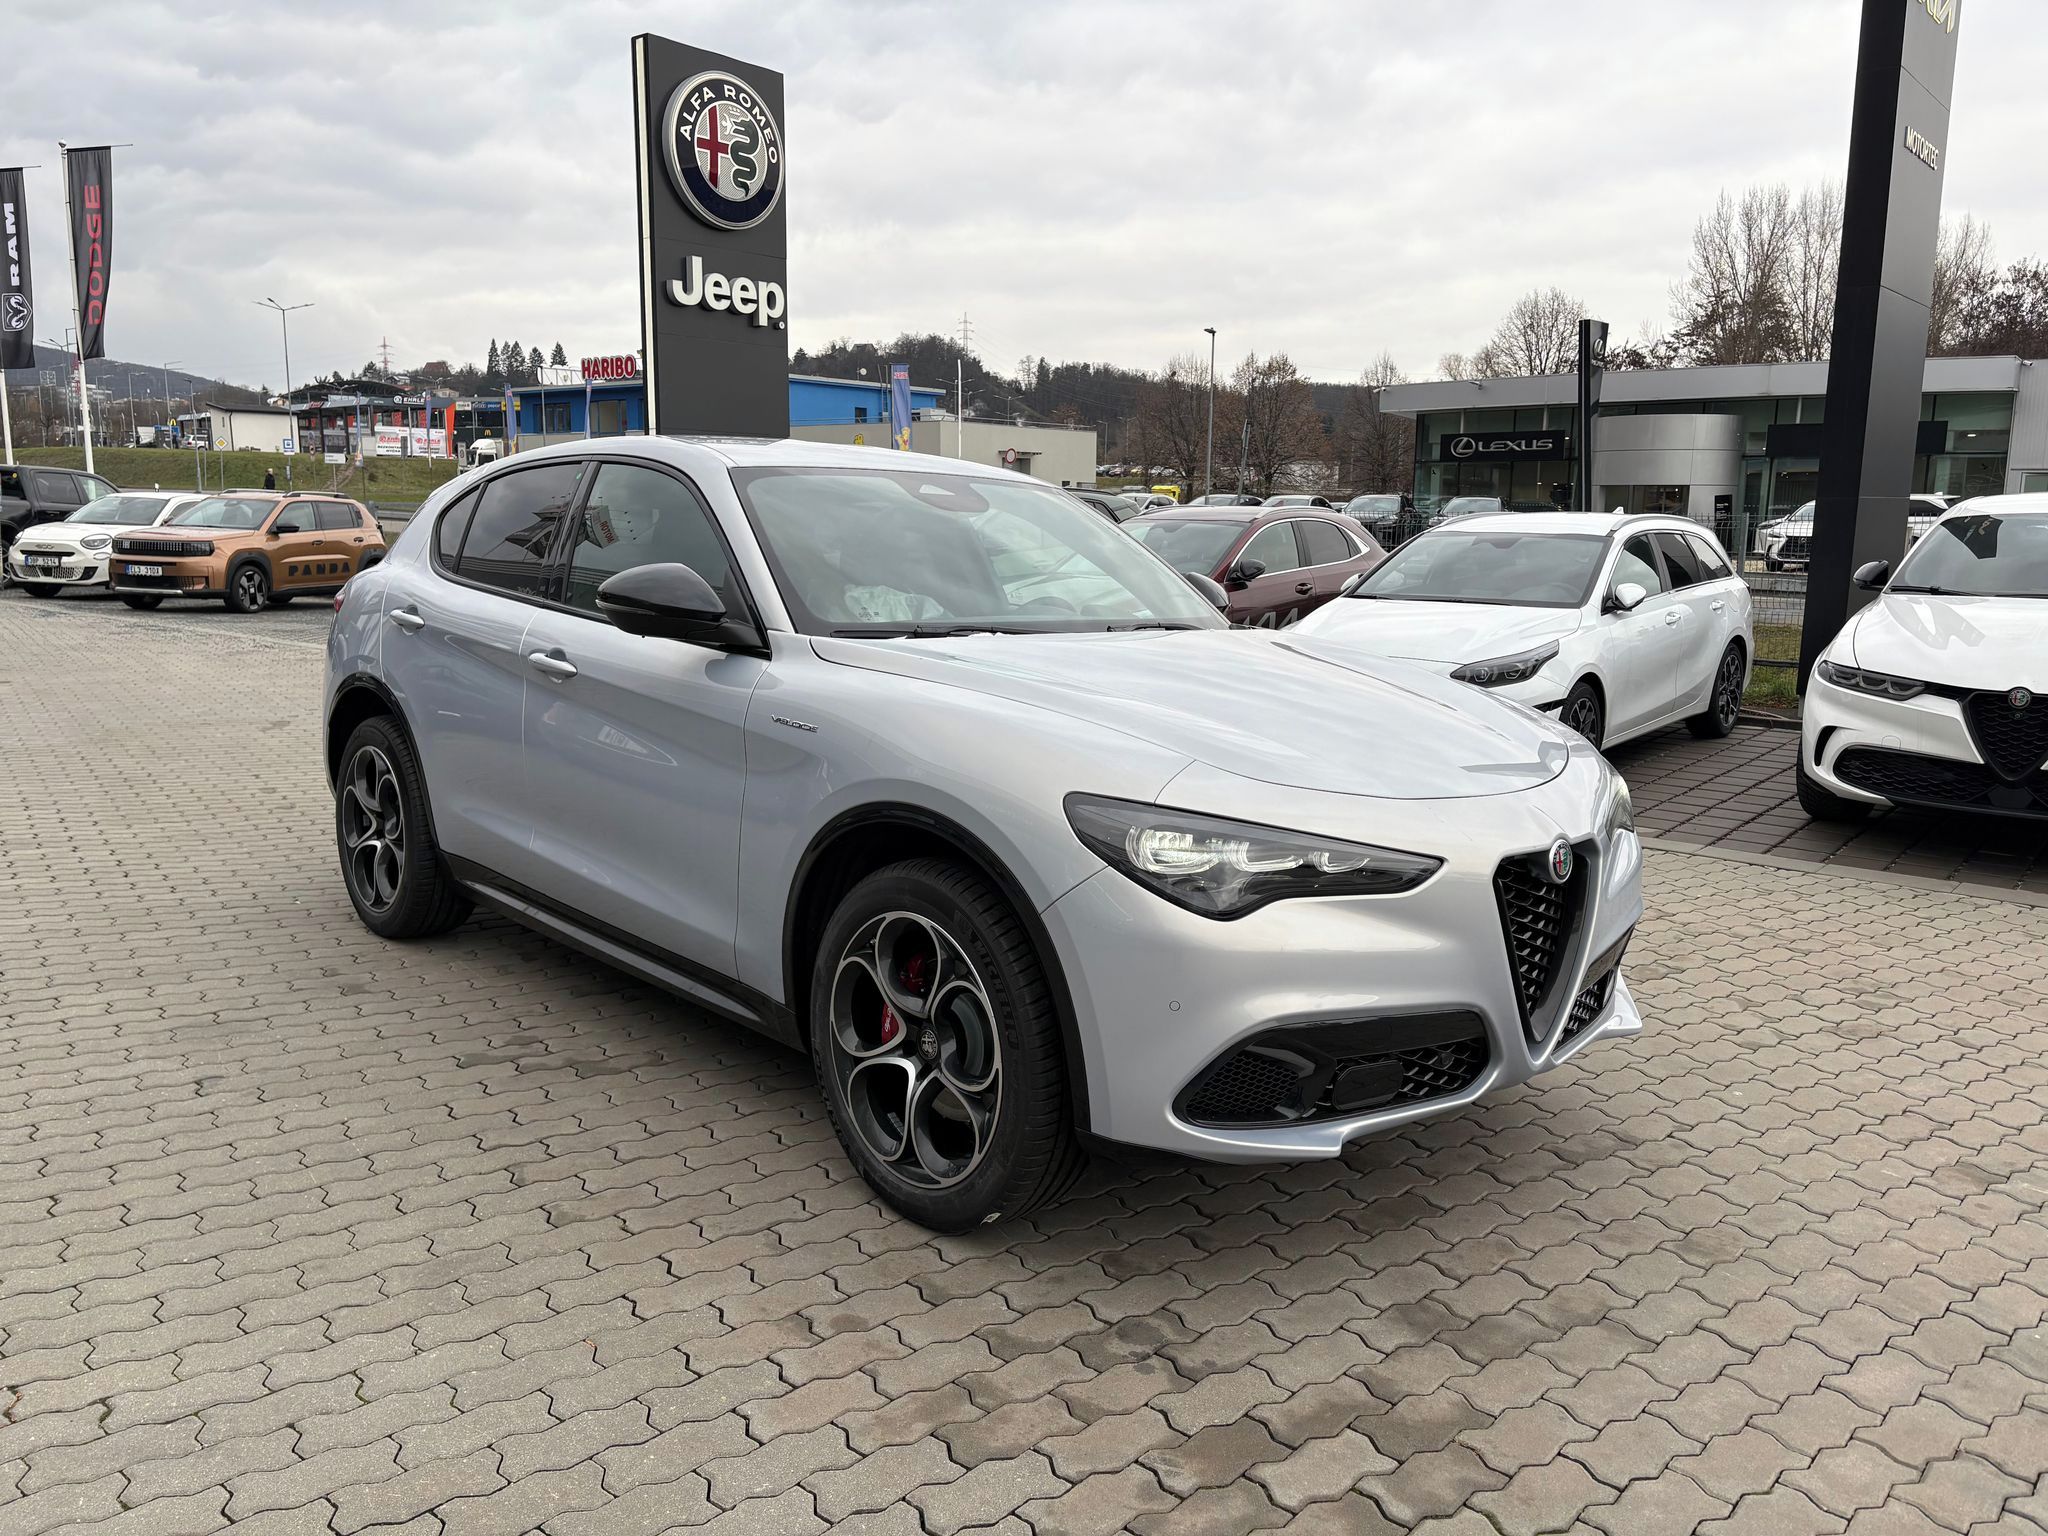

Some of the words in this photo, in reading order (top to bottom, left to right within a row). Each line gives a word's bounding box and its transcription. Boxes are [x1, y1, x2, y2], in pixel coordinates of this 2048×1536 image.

[680, 86, 716, 142] ALFA
[723, 84, 778, 164] ROMEO
[1904, 125, 1939, 171] MOTORTEC
[3, 202, 20, 287] RAM
[84, 184, 104, 326] DODGE
[666, 255, 785, 327] Jeep
[581, 354, 637, 380] HARIBO
[1477, 439, 1553, 452] LEXUS
[288, 561, 350, 577] PANDA
